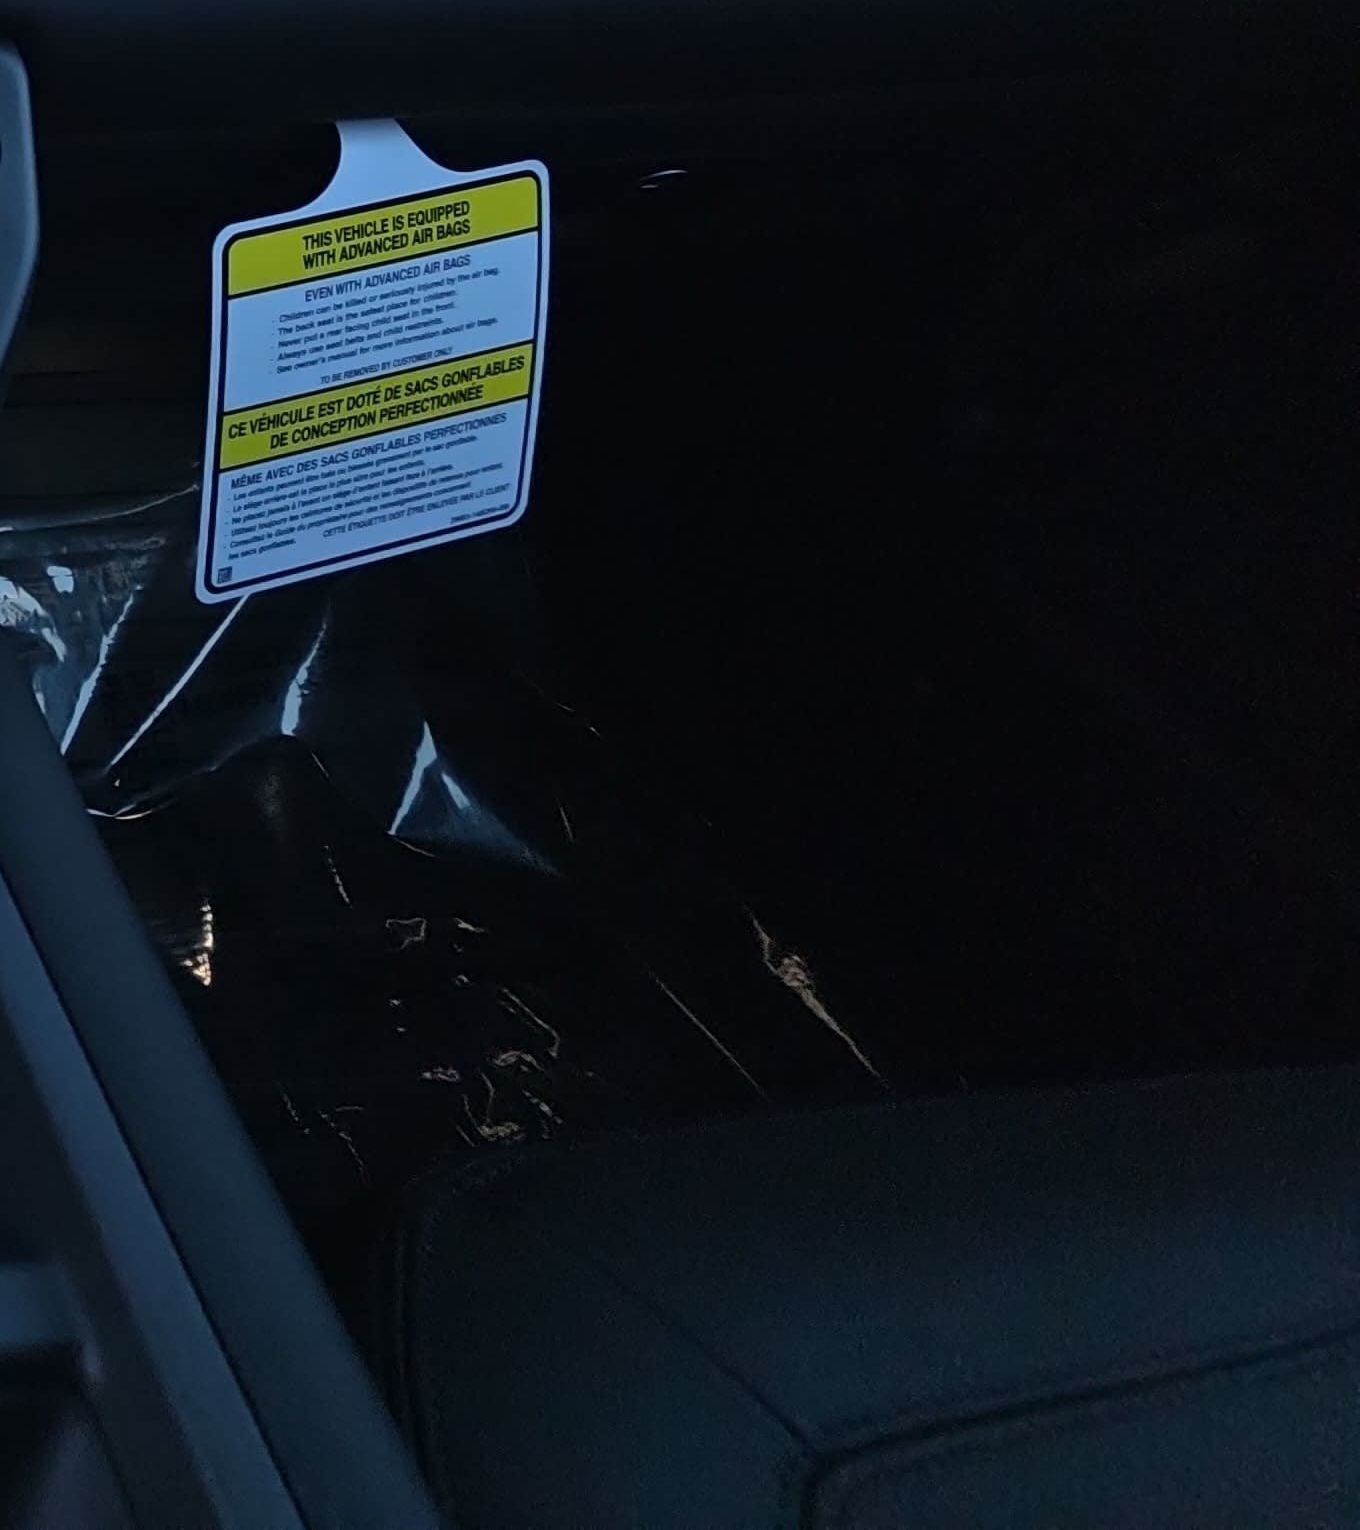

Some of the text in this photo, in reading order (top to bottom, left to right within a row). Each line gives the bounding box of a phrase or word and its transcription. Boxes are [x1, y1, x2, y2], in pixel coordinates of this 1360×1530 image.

[301, 199, 470, 251] THIS VEHICLE IS EQUIPPED
[301, 217, 471, 270] WITH ADVANCED AIR BAGS
[304, 253, 471, 302] EVEN WITH ADVANCED AIR BAGS
[227, 354, 525, 439] CE VÉHICULE EST DOTÉ DE SACS GONFLABLES
[269, 381, 484, 450] DE CONCEPTION PERFECTIONNÉE
[264, 464, 294, 481] AVEC
[295, 458, 318, 473] DES
[319, 450, 349, 467] SACS
[350, 432, 421, 460] GONFLABLES
